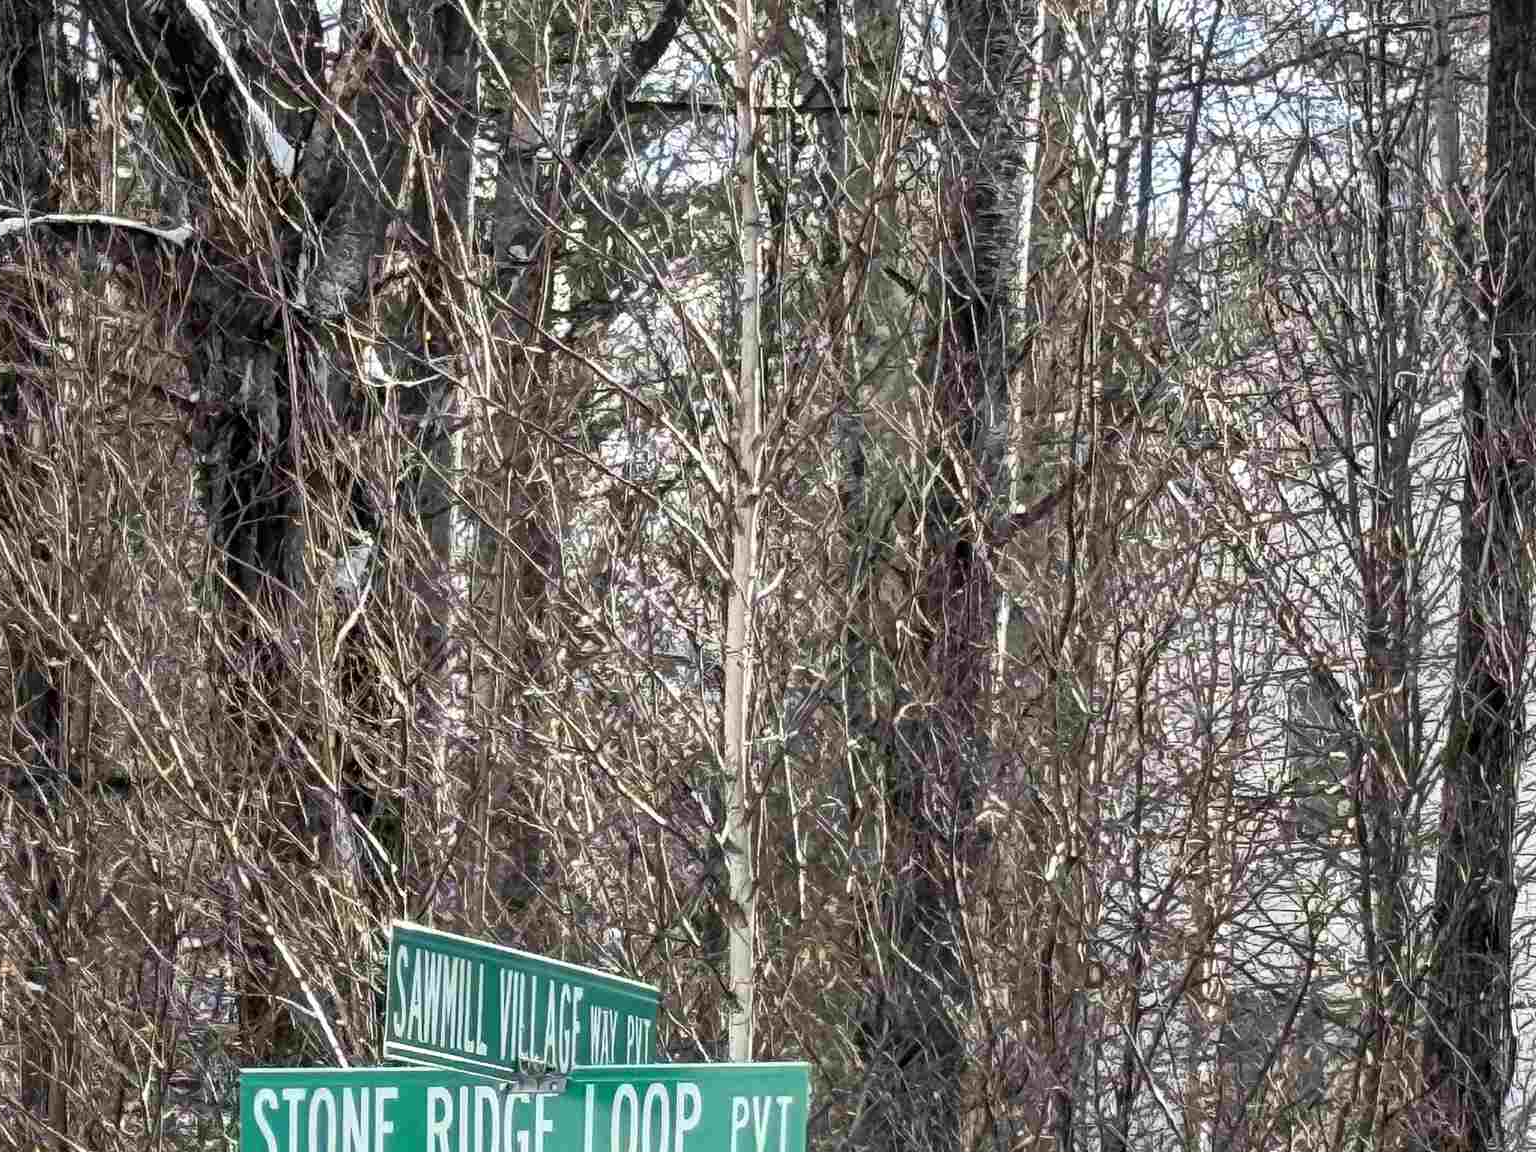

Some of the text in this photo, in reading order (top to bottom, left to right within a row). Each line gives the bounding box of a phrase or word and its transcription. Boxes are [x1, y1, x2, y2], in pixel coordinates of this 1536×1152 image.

[392, 944, 652, 1074] SAWMILL VILLAGE WAY PVT
